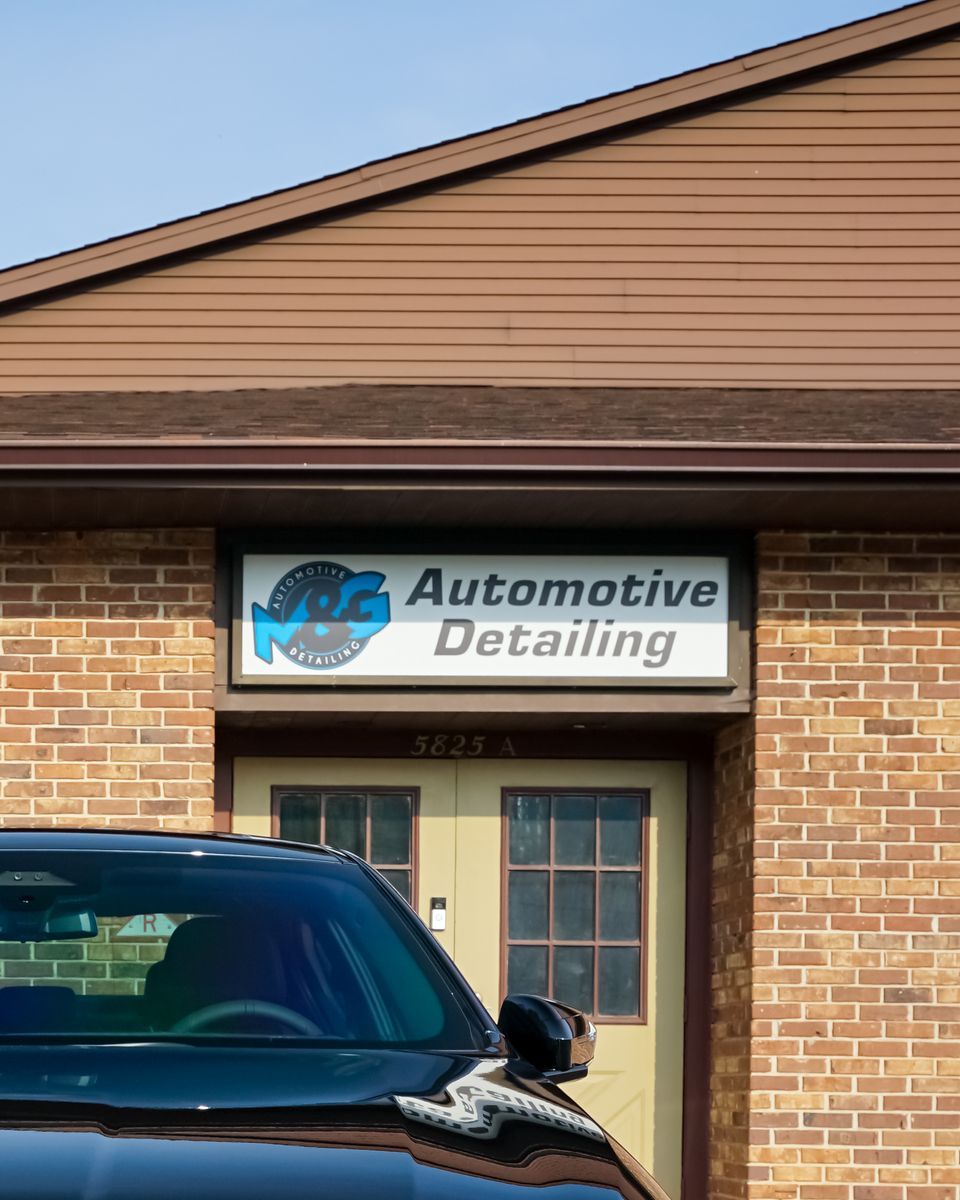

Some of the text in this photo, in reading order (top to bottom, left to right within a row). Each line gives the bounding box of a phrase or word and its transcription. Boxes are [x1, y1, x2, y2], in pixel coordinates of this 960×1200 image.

[272, 566, 346, 609] AUTOMOTIVE
[405, 568, 719, 608] Automotive
[252, 571, 391, 664] M&G
[289, 640, 360, 665] DETAILING
[434, 618, 677, 668] Detailing
[410, 734, 517, 756] 5825 A
[143, 914, 157, 932] R
